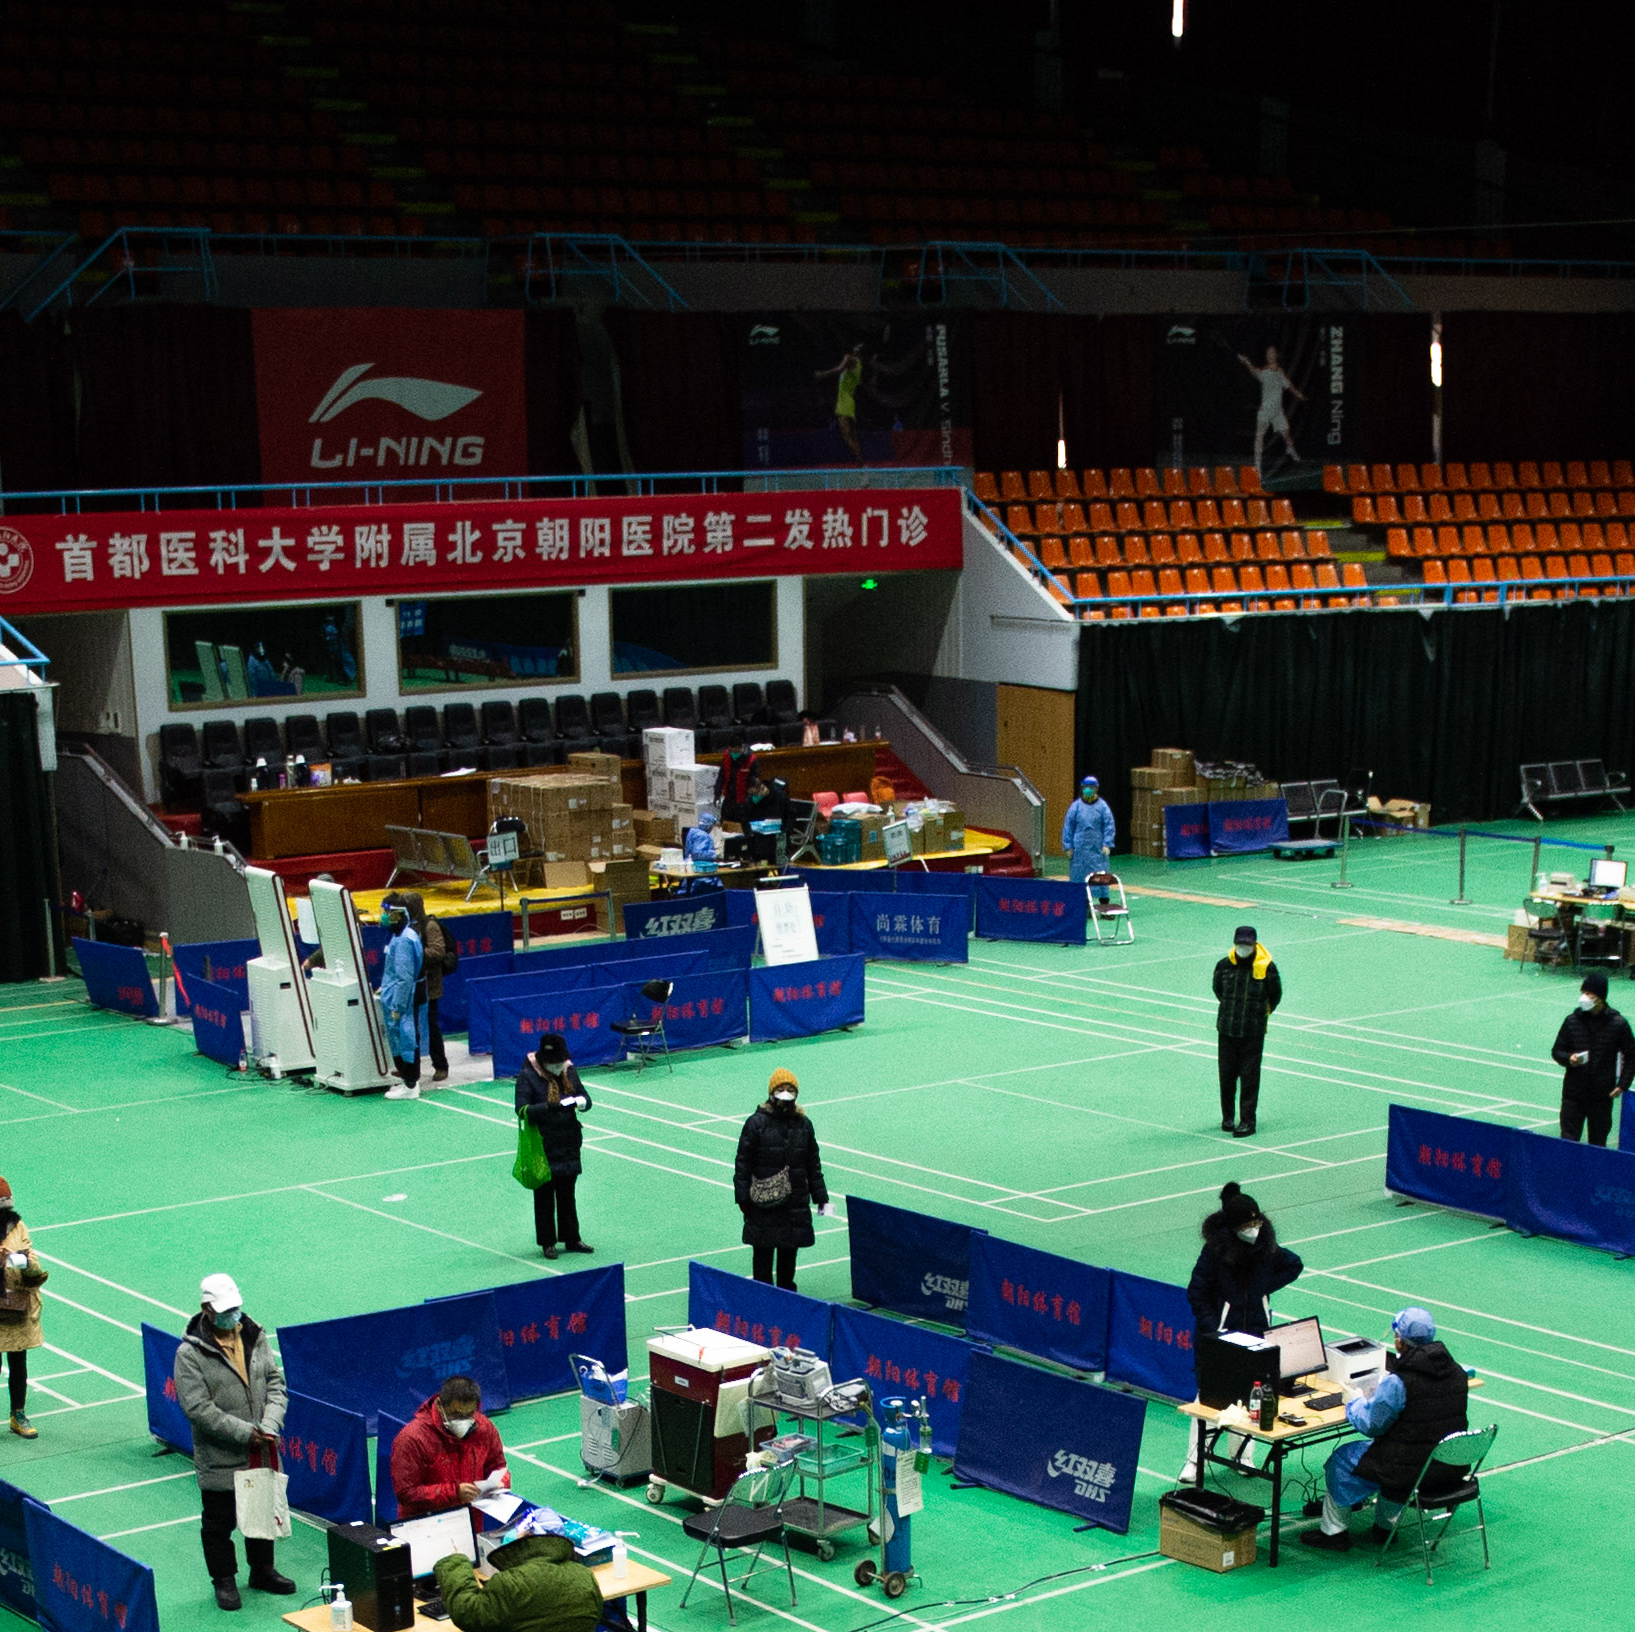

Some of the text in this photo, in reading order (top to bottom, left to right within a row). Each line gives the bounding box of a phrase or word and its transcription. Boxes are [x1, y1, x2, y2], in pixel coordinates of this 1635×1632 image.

[1326, 325, 1345, 446] ZHANG Ning
[310, 434, 486, 470] LI-NING
[55, 504, 930, 583] 首都医科大学附属北京朝阳医院第二发热门诊
[876, 913, 942, 935] 尚霖体育
[498, 1310, 589, 1348] 阳体育馆
[1138, 1314, 1195, 1351] 朝阳体
[864, 1353, 963, 1403] 朝阳体育馆
[1046, 1449, 1118, 1489] 红双喜
[1074, 1479, 1112, 1504] DHS
